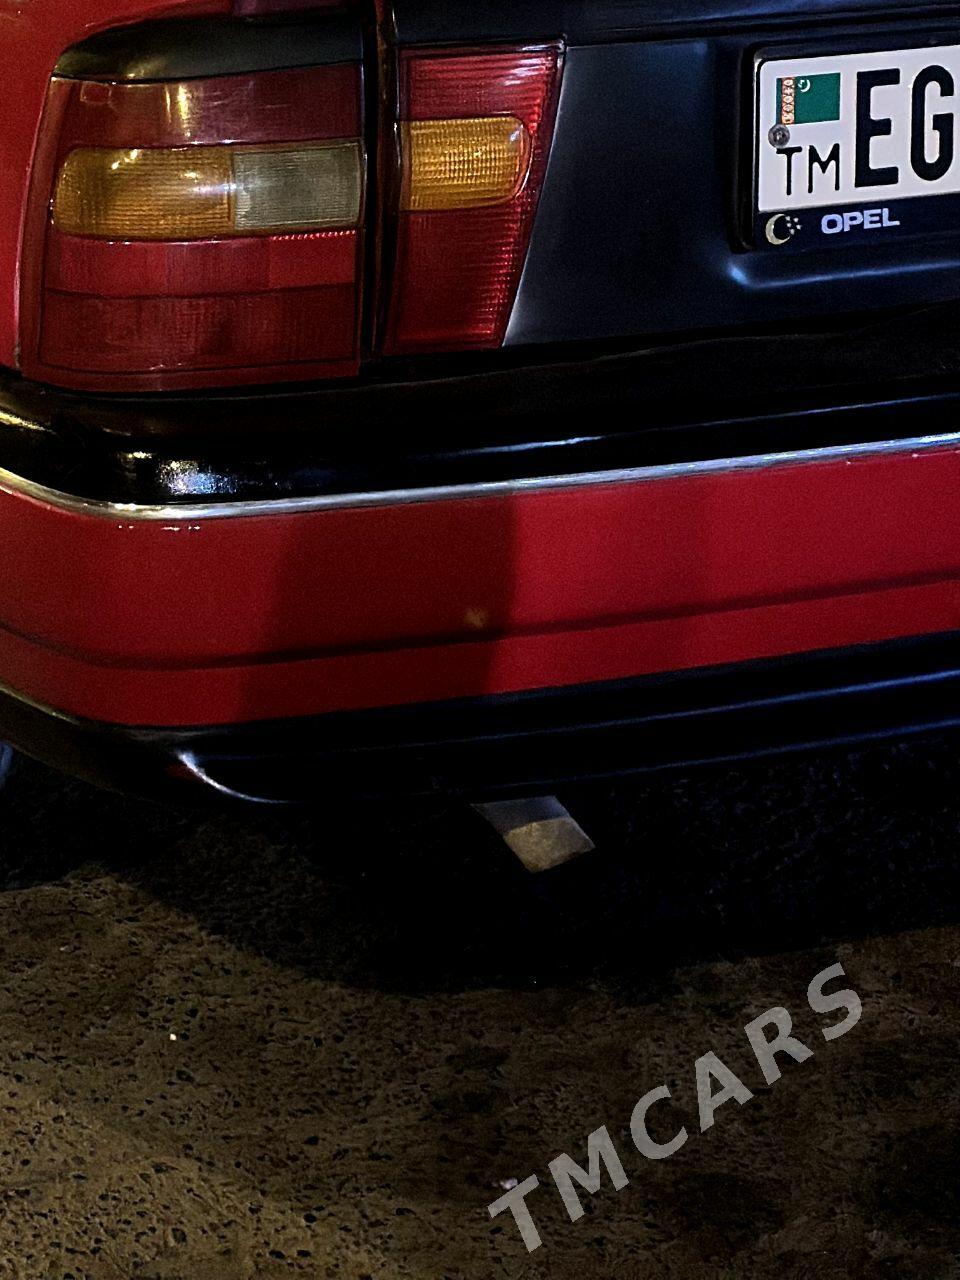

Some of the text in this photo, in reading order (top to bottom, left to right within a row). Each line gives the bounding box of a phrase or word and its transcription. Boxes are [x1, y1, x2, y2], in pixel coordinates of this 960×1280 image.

[855, 64, 954, 188] EG
[776, 143, 840, 195] TM
[821, 208, 900, 234] OPEL
